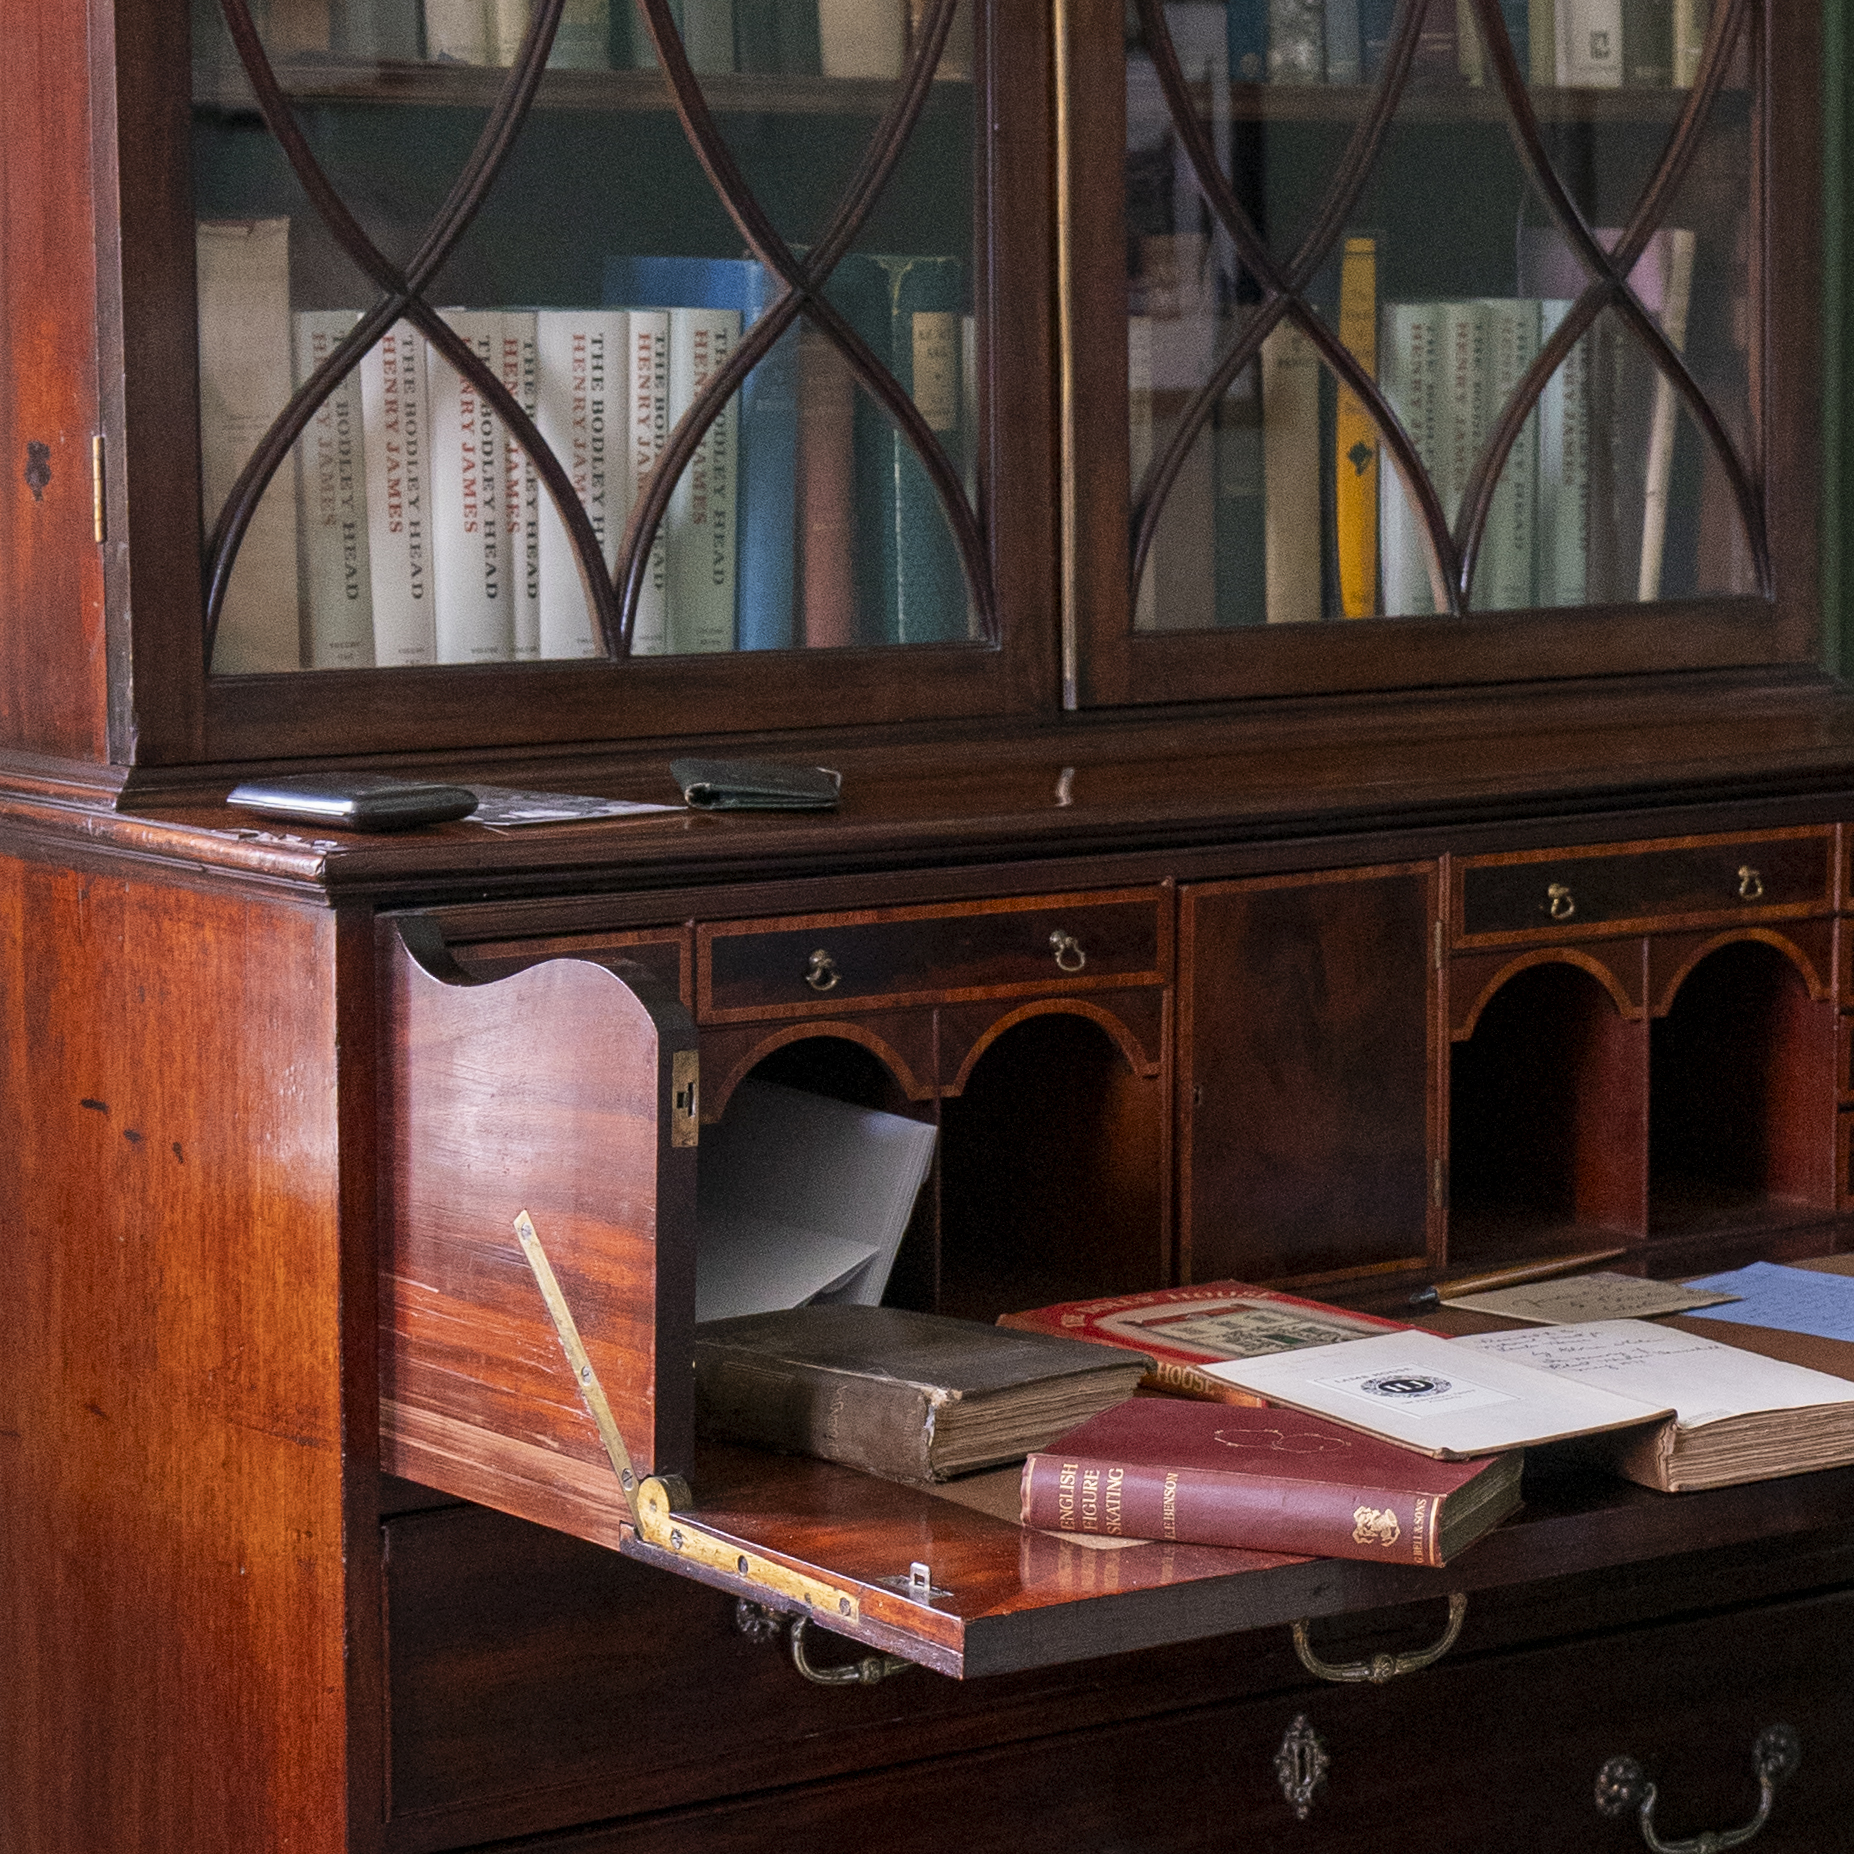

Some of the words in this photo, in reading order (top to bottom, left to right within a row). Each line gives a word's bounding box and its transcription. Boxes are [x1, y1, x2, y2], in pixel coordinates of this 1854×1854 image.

[382, 333, 400, 435] HENRY
[401, 334, 416, 395] THE
[522, 337, 536, 394] THE
[572, 333, 588, 437] HENRY
[590, 332, 605, 392] THE
[637, 332, 652, 430] HENRY
[654, 333, 666, 391] THE
[335, 400, 355, 513] BODLEY
[385, 440, 404, 534] JAMES
[404, 401, 421, 513] BODLEY
[461, 440, 479, 534] JAMES
[590, 399, 606, 507] BODLEY
[341, 520, 360, 601] HEAD
[408, 519, 424, 600] HEAD
[483, 519, 499, 600] HEAD
[526, 520, 539, 600] HEAD
[712, 510, 727, 587] HEAD
[1157, 1362, 1215, 1396] HOUSE
[1058, 1462, 1079, 1531] ENGLISH
[1080, 1468, 1100, 1533] FIGURE
[1104, 1466, 1125, 1535] SKATING
